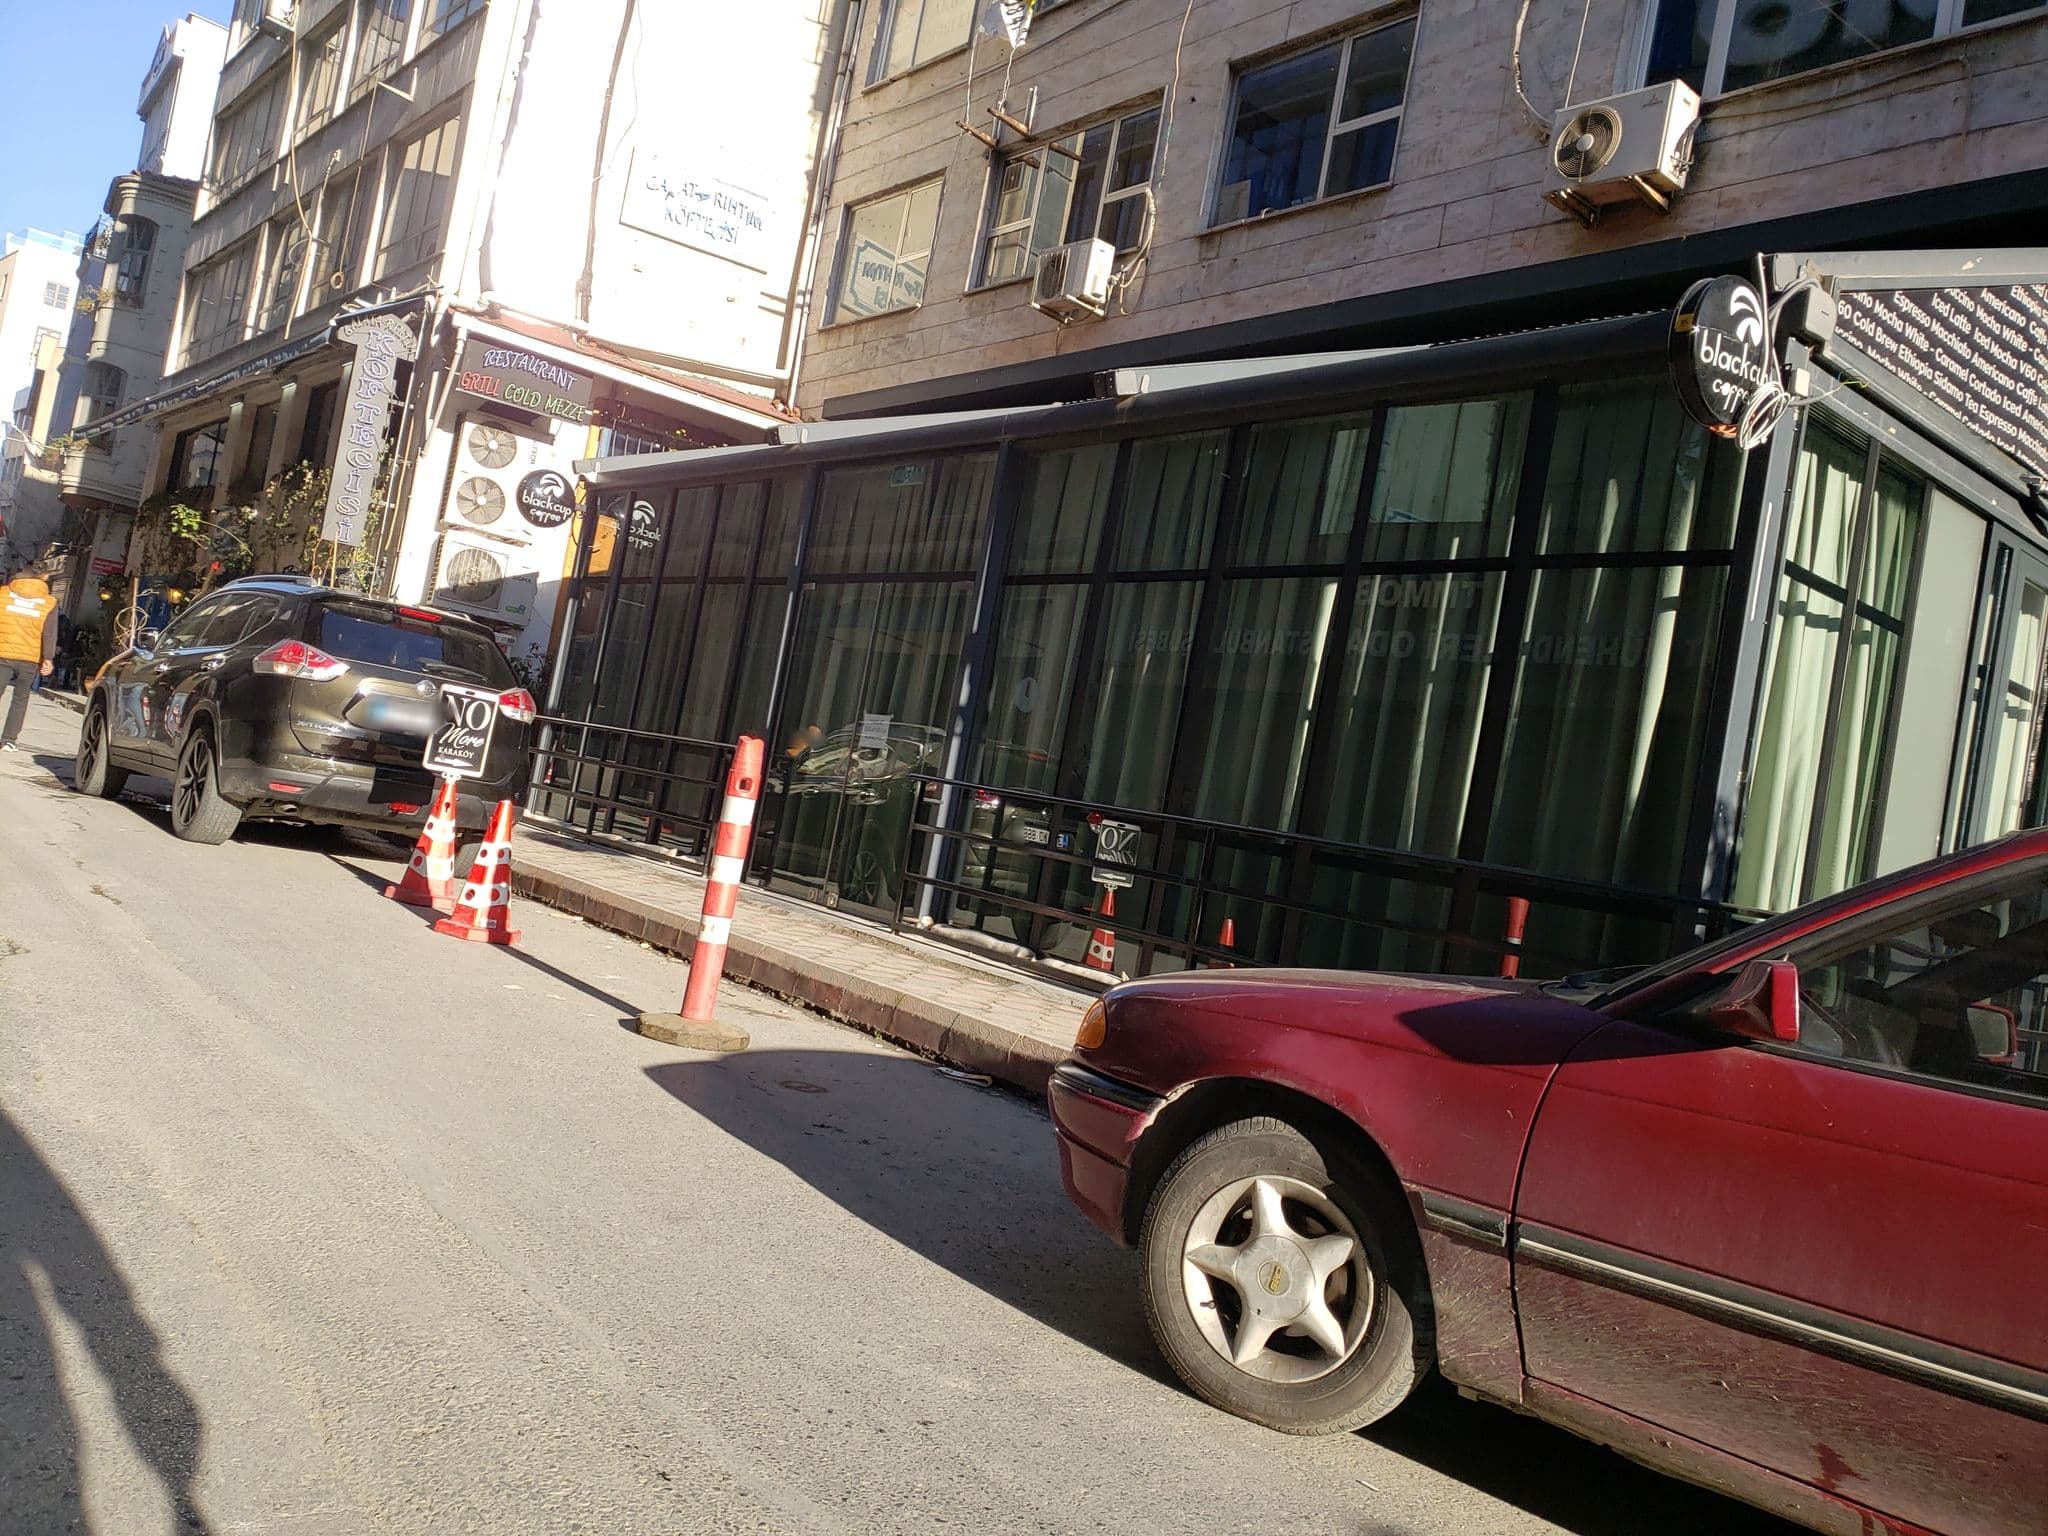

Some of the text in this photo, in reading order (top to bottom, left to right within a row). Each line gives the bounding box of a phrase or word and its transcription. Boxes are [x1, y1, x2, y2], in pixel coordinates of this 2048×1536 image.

[1980, 288, 2027, 327] Americano
[2011, 285, 2042, 317] Ethiopia
[1893, 290, 1930, 327] Espresso
[1931, 321, 1972, 359] Macchiato
[1971, 351, 2015, 390] Americano
[1931, 292, 1950, 317] Iced
[1949, 307, 1972, 334] Latte
[1973, 327, 1991, 350] Iced
[1990, 341, 2018, 370] Mocha
[2019, 359, 2037, 381] V60
[1976, 303, 2001, 335] Mocha
[2002, 325, 2028, 352] White
[483, 349, 578, 391] RESTAURANT
[1853, 311, 1876, 337] Cold
[1875, 326, 1899, 354] Brew
[1898, 344, 1934, 380] Ethiopia
[1933, 371, 1964, 402] Sidamo
[1964, 392, 1979, 414] Tea
[1979, 404, 2018, 437] Espresso
[1874, 299, 1904, 333] Mocha
[1905, 322, 1930, 352] White
[1935, 348, 1969, 382] Caramel
[1969, 373, 2002, 405] Cortado
[2002, 395, 2022, 417] Iced
[460, 371, 588, 422] GRILL COLD MEZZE
[530, 507, 562, 524] coffee
[444, 694, 492, 731] NO
[434, 722, 485, 749] More
[438, 746, 475, 759] KARAKÖY
